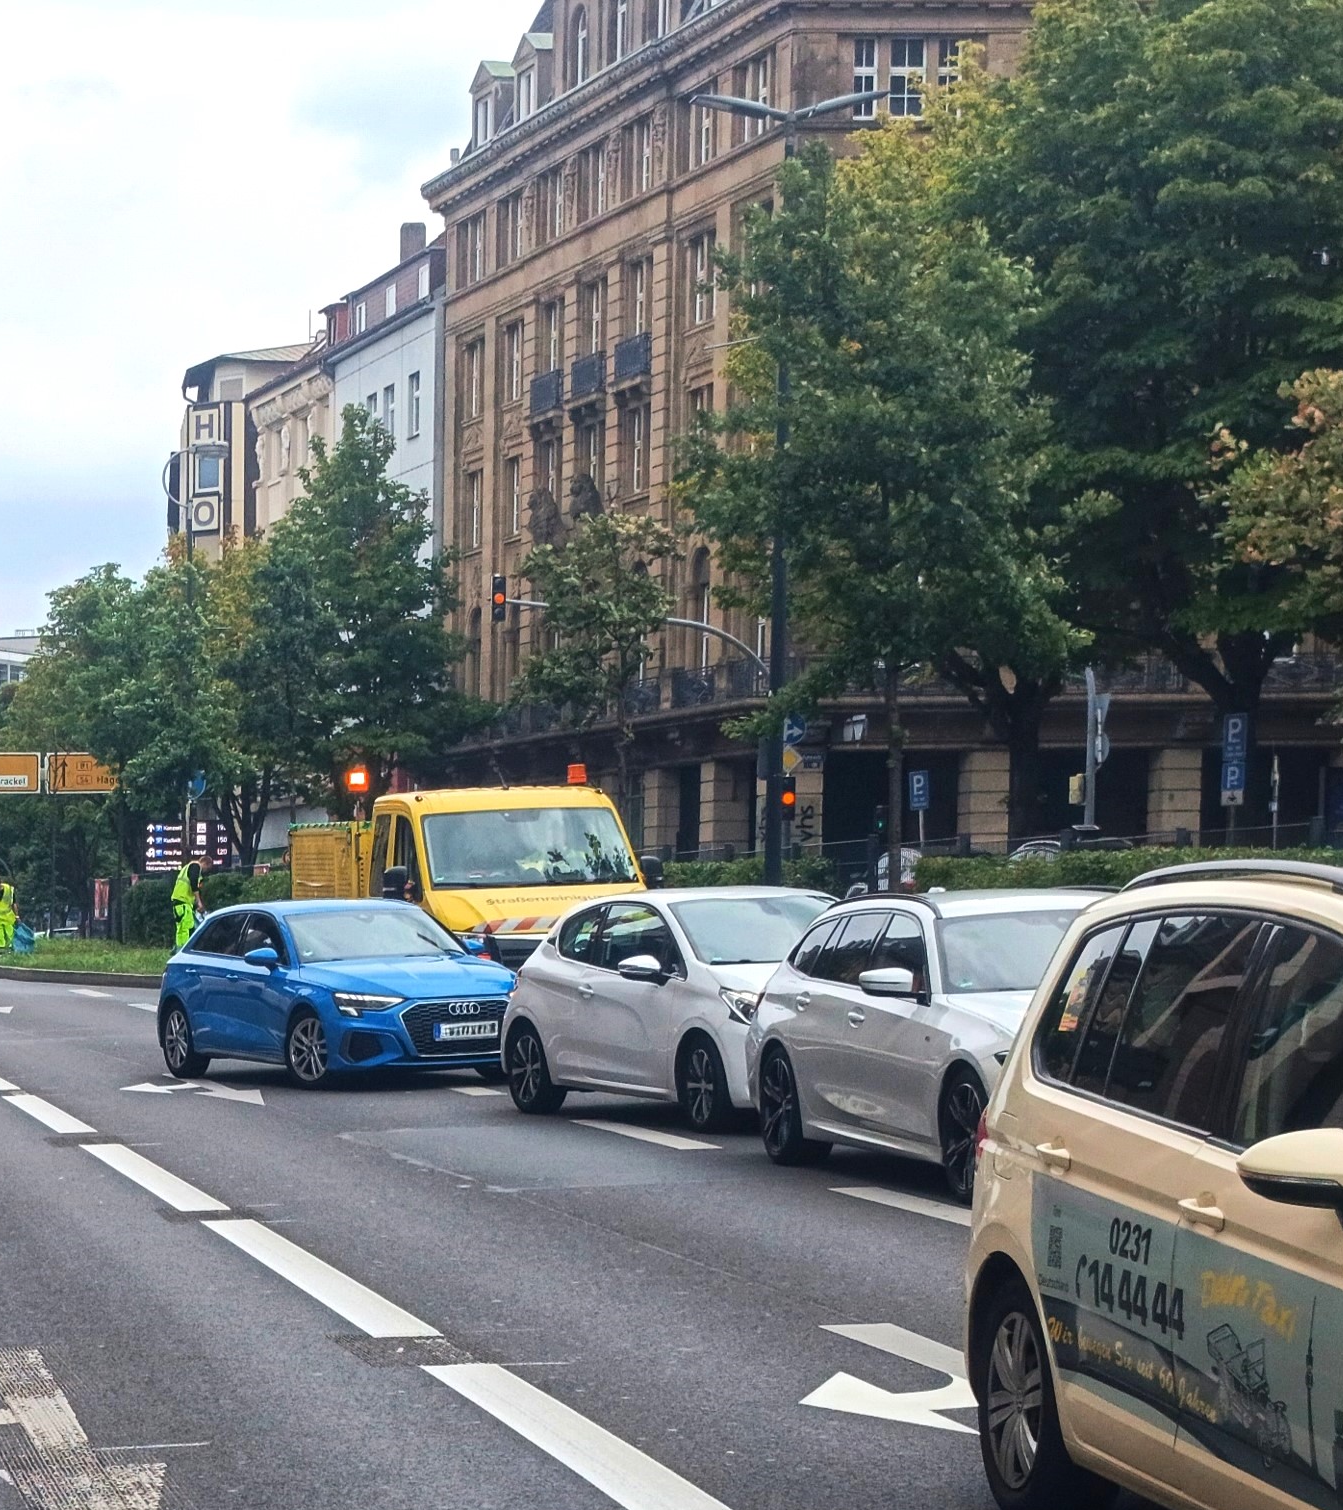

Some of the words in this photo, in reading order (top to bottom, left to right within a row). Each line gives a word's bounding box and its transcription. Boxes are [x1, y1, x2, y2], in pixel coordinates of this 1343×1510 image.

[795, 804, 815, 842] vhs
[1109, 1217, 1153, 1266] 0231
[1047, 1316, 1074, 1345] Wir
[1115, 1340, 1134, 1371] Sie
[1159, 1366, 1175, 1394] 60
